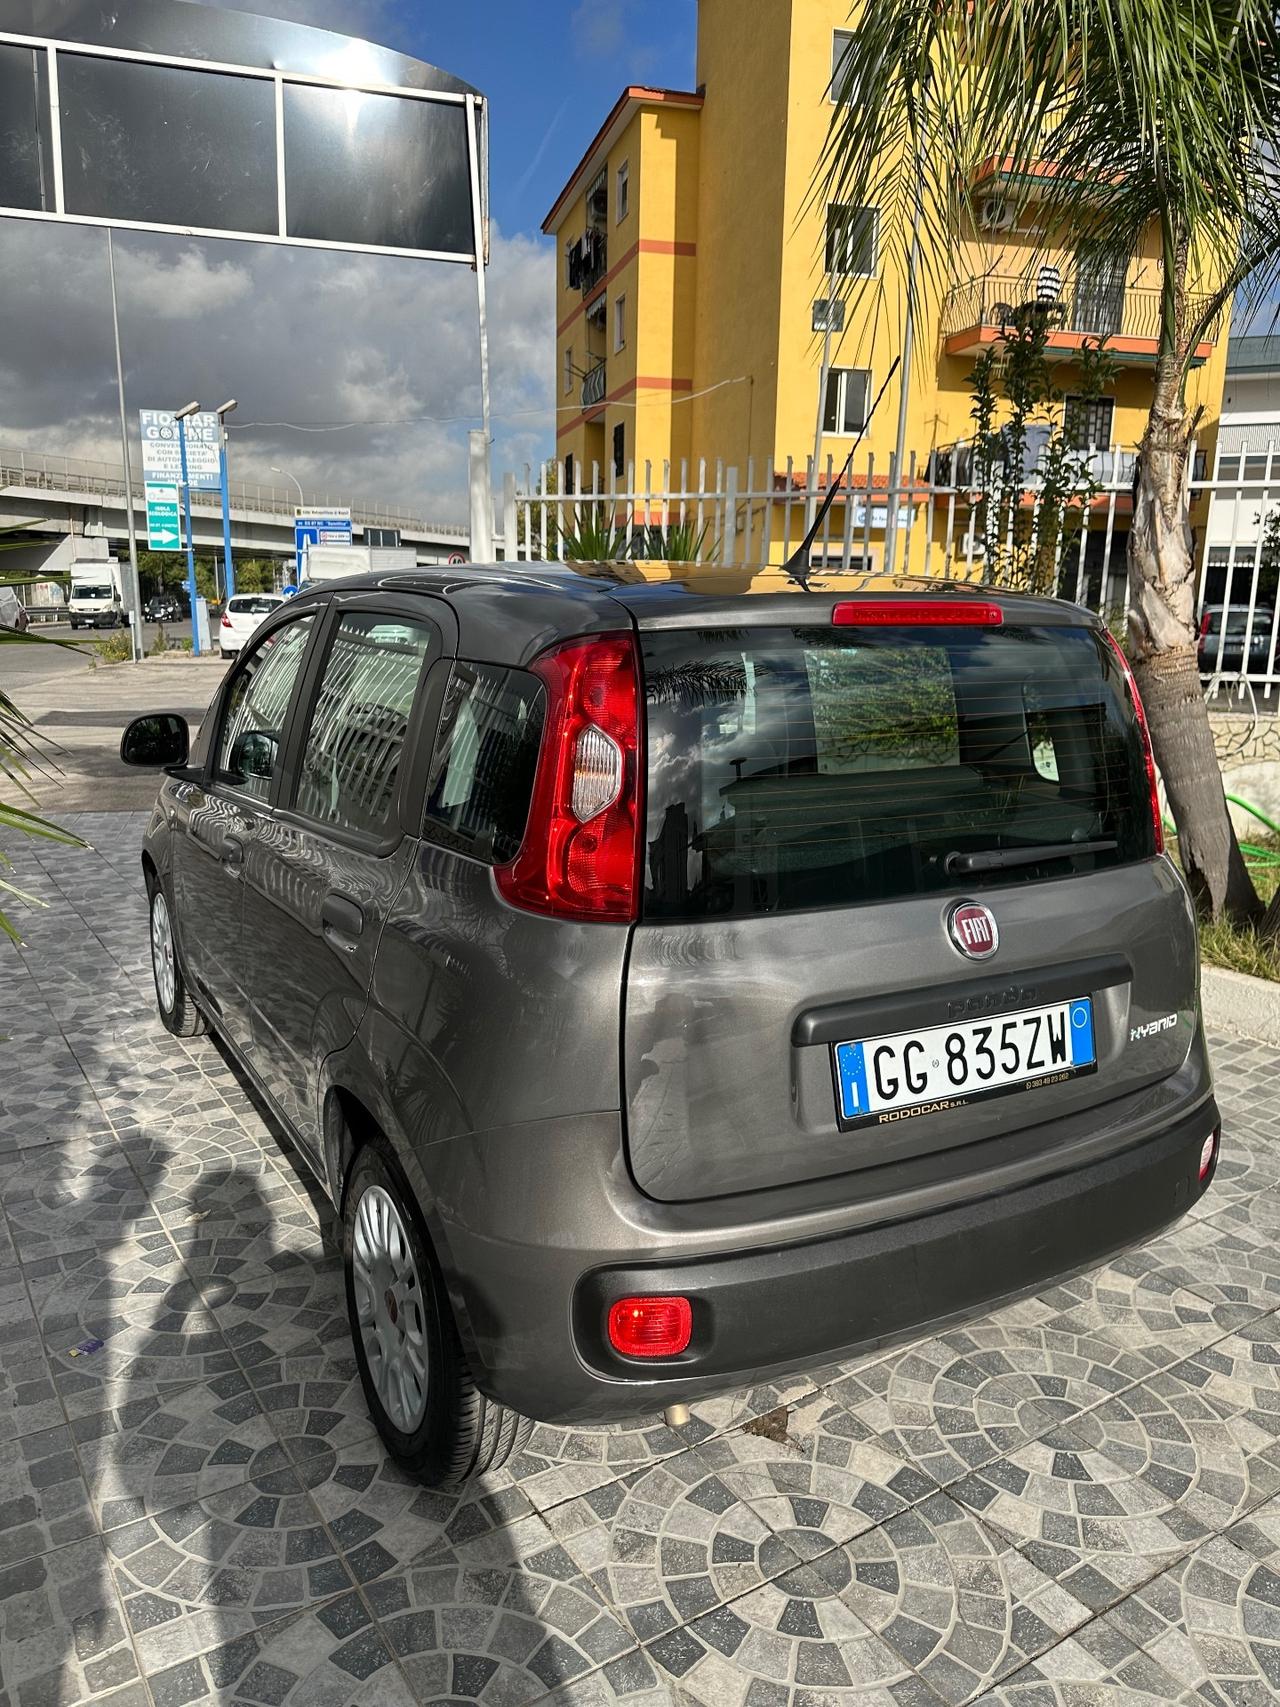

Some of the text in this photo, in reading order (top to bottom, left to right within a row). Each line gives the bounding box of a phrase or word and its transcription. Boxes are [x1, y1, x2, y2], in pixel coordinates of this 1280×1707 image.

[961, 916, 991, 945] FIAT
[873, 1011, 1068, 1101] GG 835ZW
[878, 1101, 950, 1124] RODOCAR
